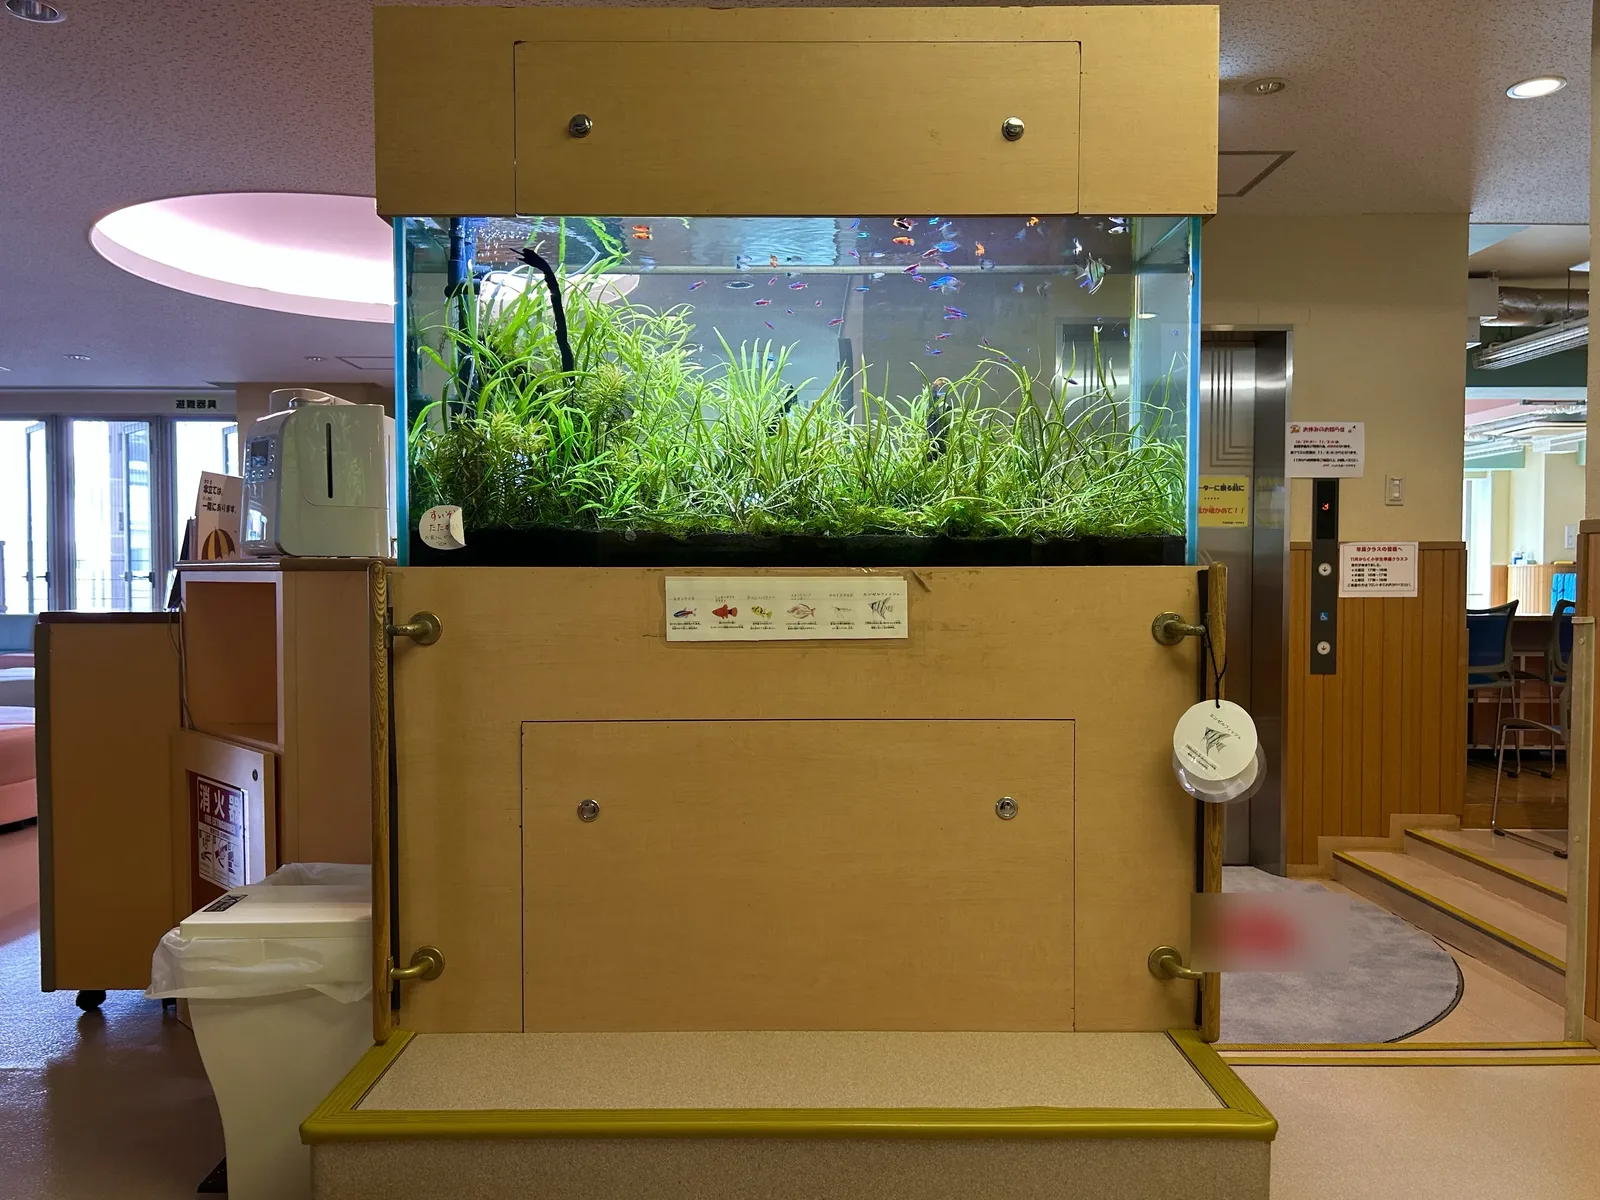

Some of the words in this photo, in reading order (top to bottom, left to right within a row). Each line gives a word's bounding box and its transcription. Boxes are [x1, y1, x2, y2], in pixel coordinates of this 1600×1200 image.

[175, 399, 217, 410] 避難器具
[199, 784, 241, 824] 消火器
